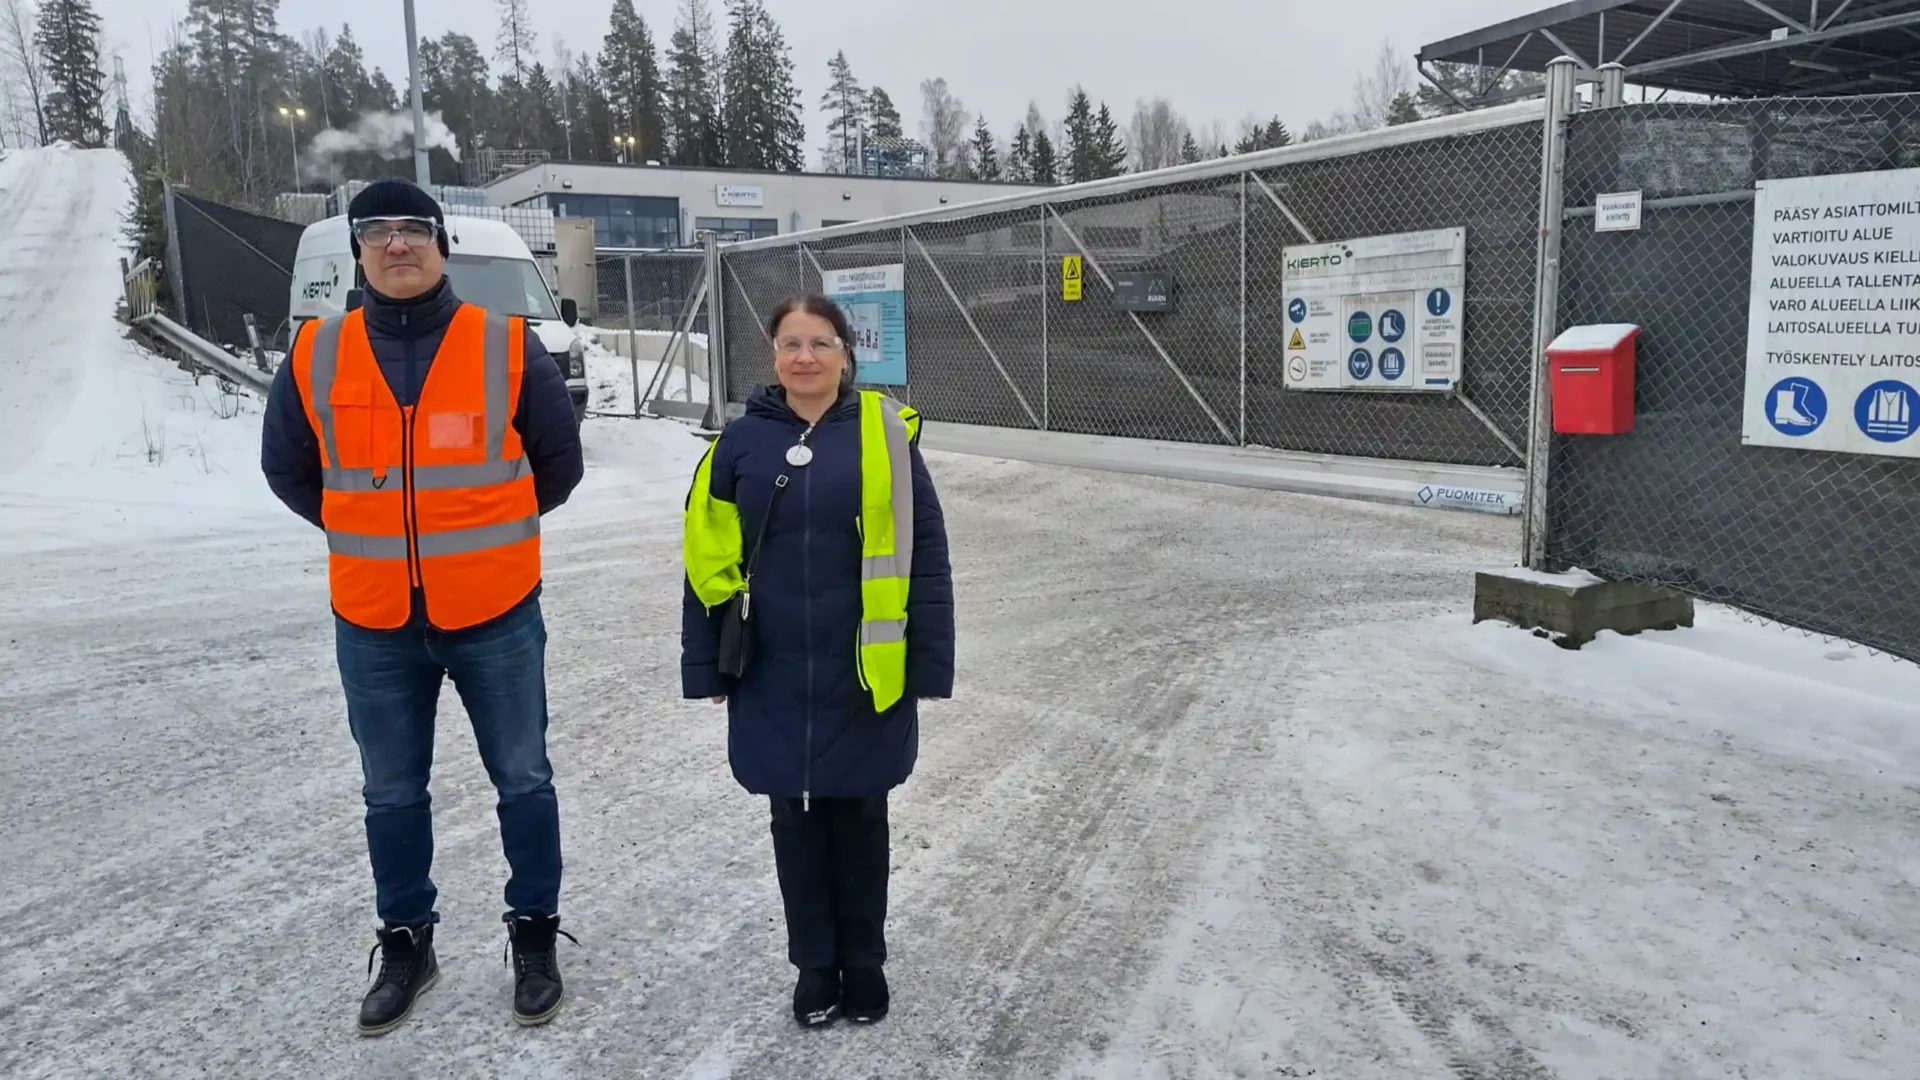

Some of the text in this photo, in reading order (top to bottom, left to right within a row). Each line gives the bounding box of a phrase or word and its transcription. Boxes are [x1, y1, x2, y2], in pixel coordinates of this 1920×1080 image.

[727, 191, 758, 199] KIERTO
[1774, 207, 1820, 223] PÄÄSY
[1772, 226, 1893, 245] VARTIOITU ALUE
[1286, 254, 1342, 270] KIERTO
[1771, 250, 1920, 267] VALOKUVAUS KIELL
[302, 281, 332, 299] KIERTO
[1769, 273, 1920, 290] ALUEELLA TALLENTA
[1769, 297, 1920, 312] VARO ALUEELLA LIIK
[1768, 321, 1920, 335] LAITOSALUEELLA TU
[1766, 350, 1866, 367] TYÖSKENTELY
[1436, 487, 1505, 504] PUOMITEK
